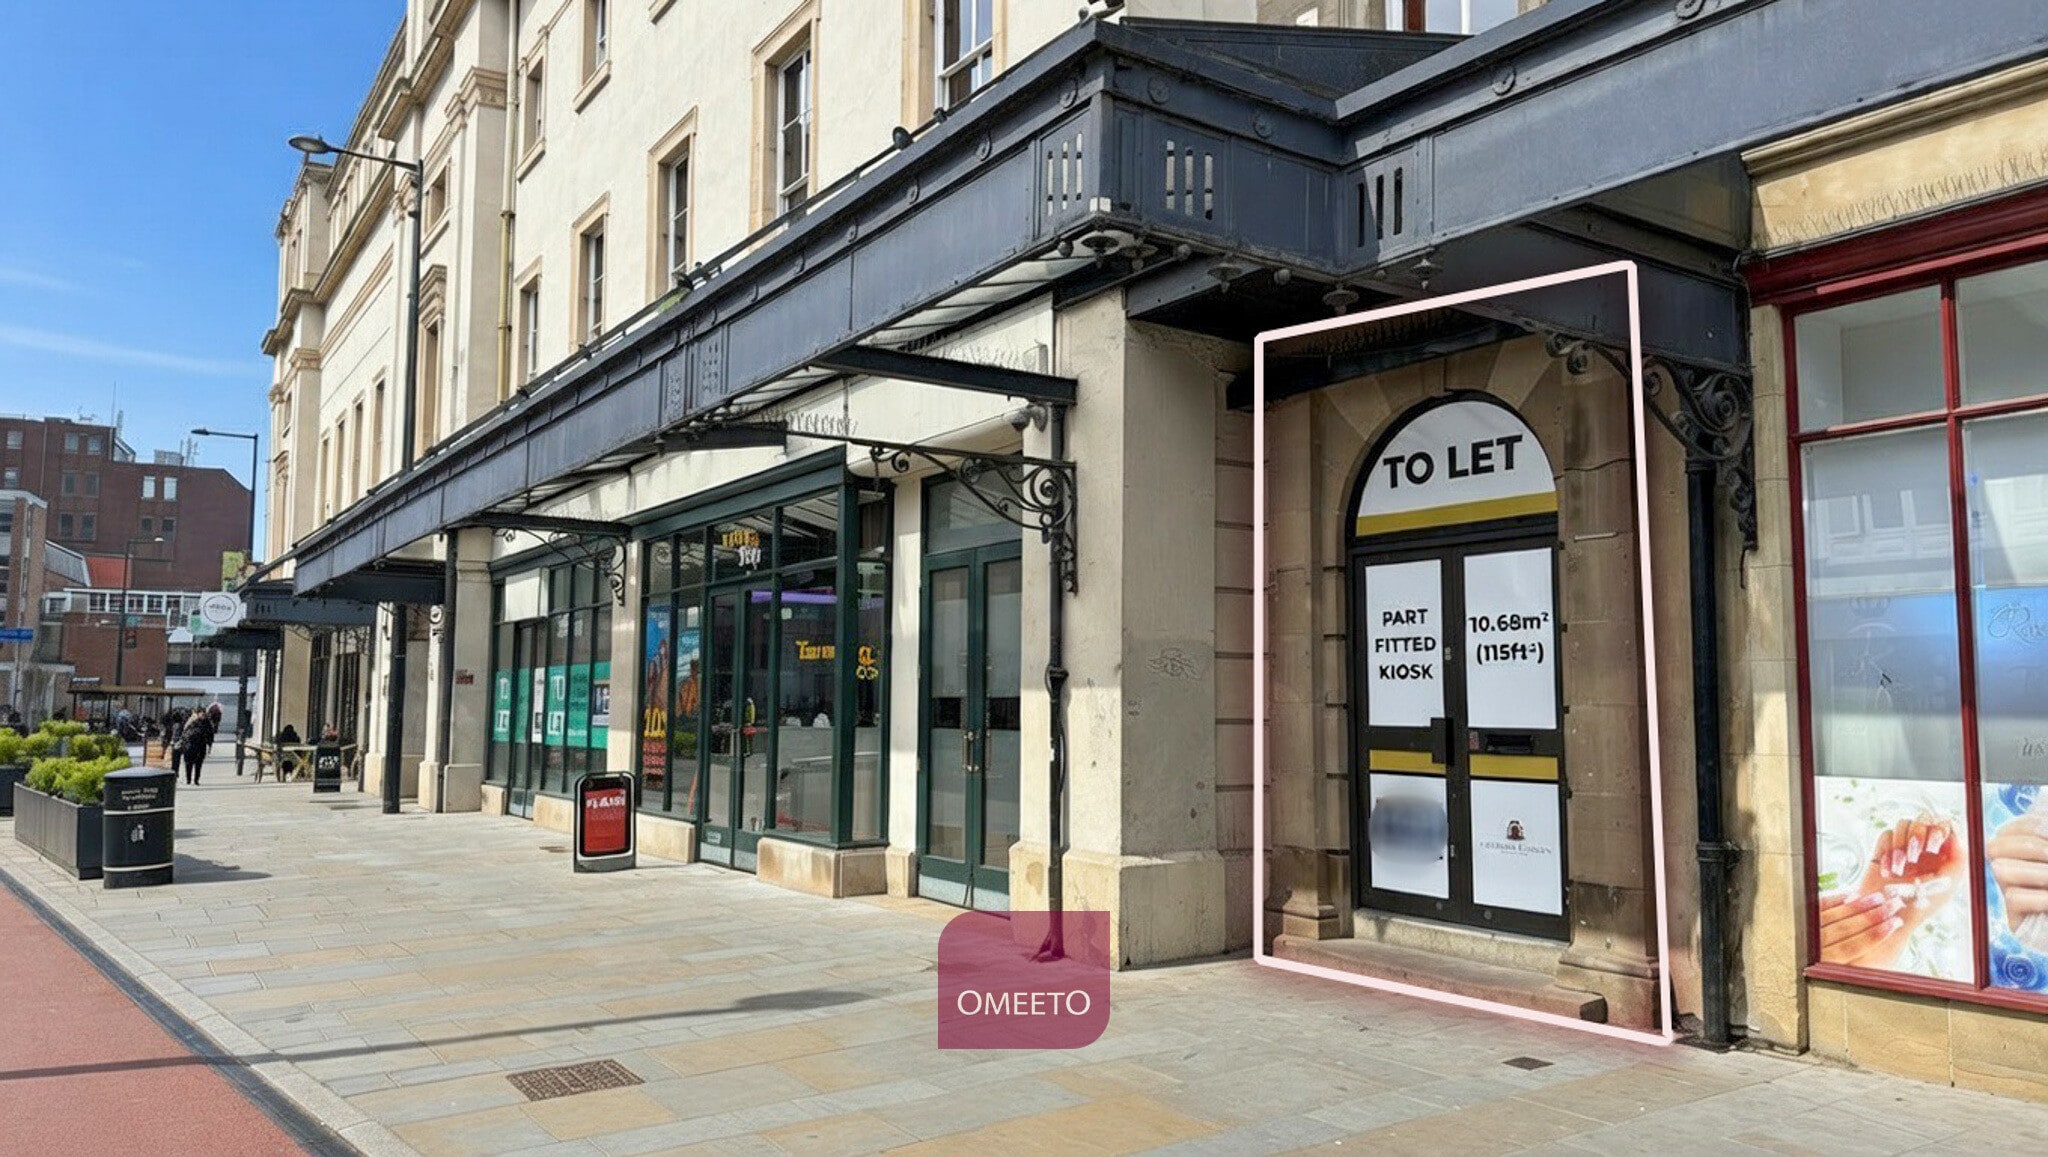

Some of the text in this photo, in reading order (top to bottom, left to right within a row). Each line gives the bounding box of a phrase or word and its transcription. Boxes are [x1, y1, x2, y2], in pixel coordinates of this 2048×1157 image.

[1383, 434, 1523, 489] TO LET
[1382, 608, 1429, 627] PART
[1375, 636, 1437, 653] FITTED
[1379, 663, 1434, 680] KIOSK
